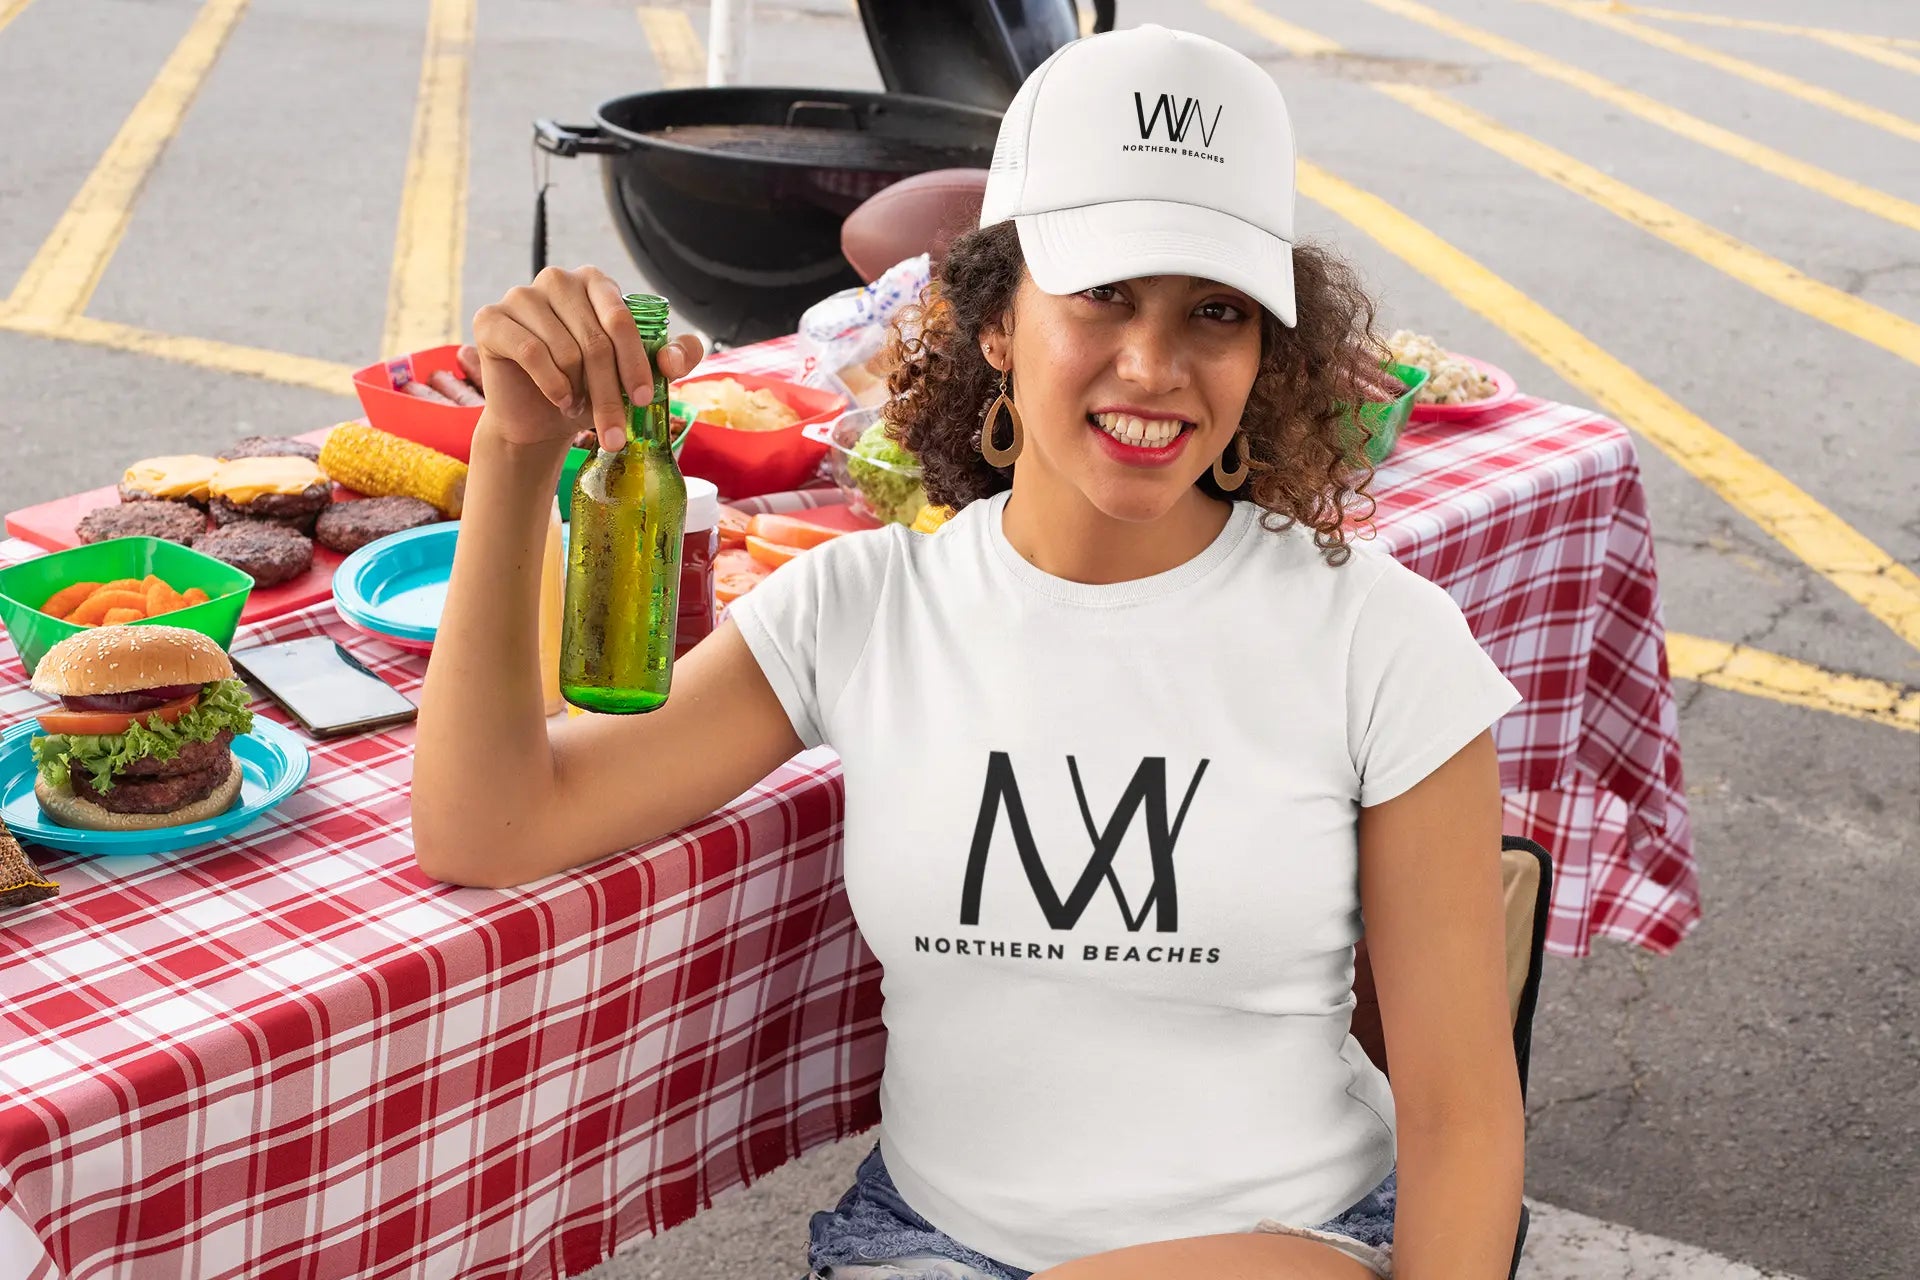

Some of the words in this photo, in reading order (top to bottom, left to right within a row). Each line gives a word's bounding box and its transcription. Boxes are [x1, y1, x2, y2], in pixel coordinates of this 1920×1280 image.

[1122, 144, 1178, 155] NORTHERN
[1181, 148, 1225, 164] BEACHES
[915, 935, 1064, 960] NORTHERN
[1082, 945, 1221, 963] BEACHES
